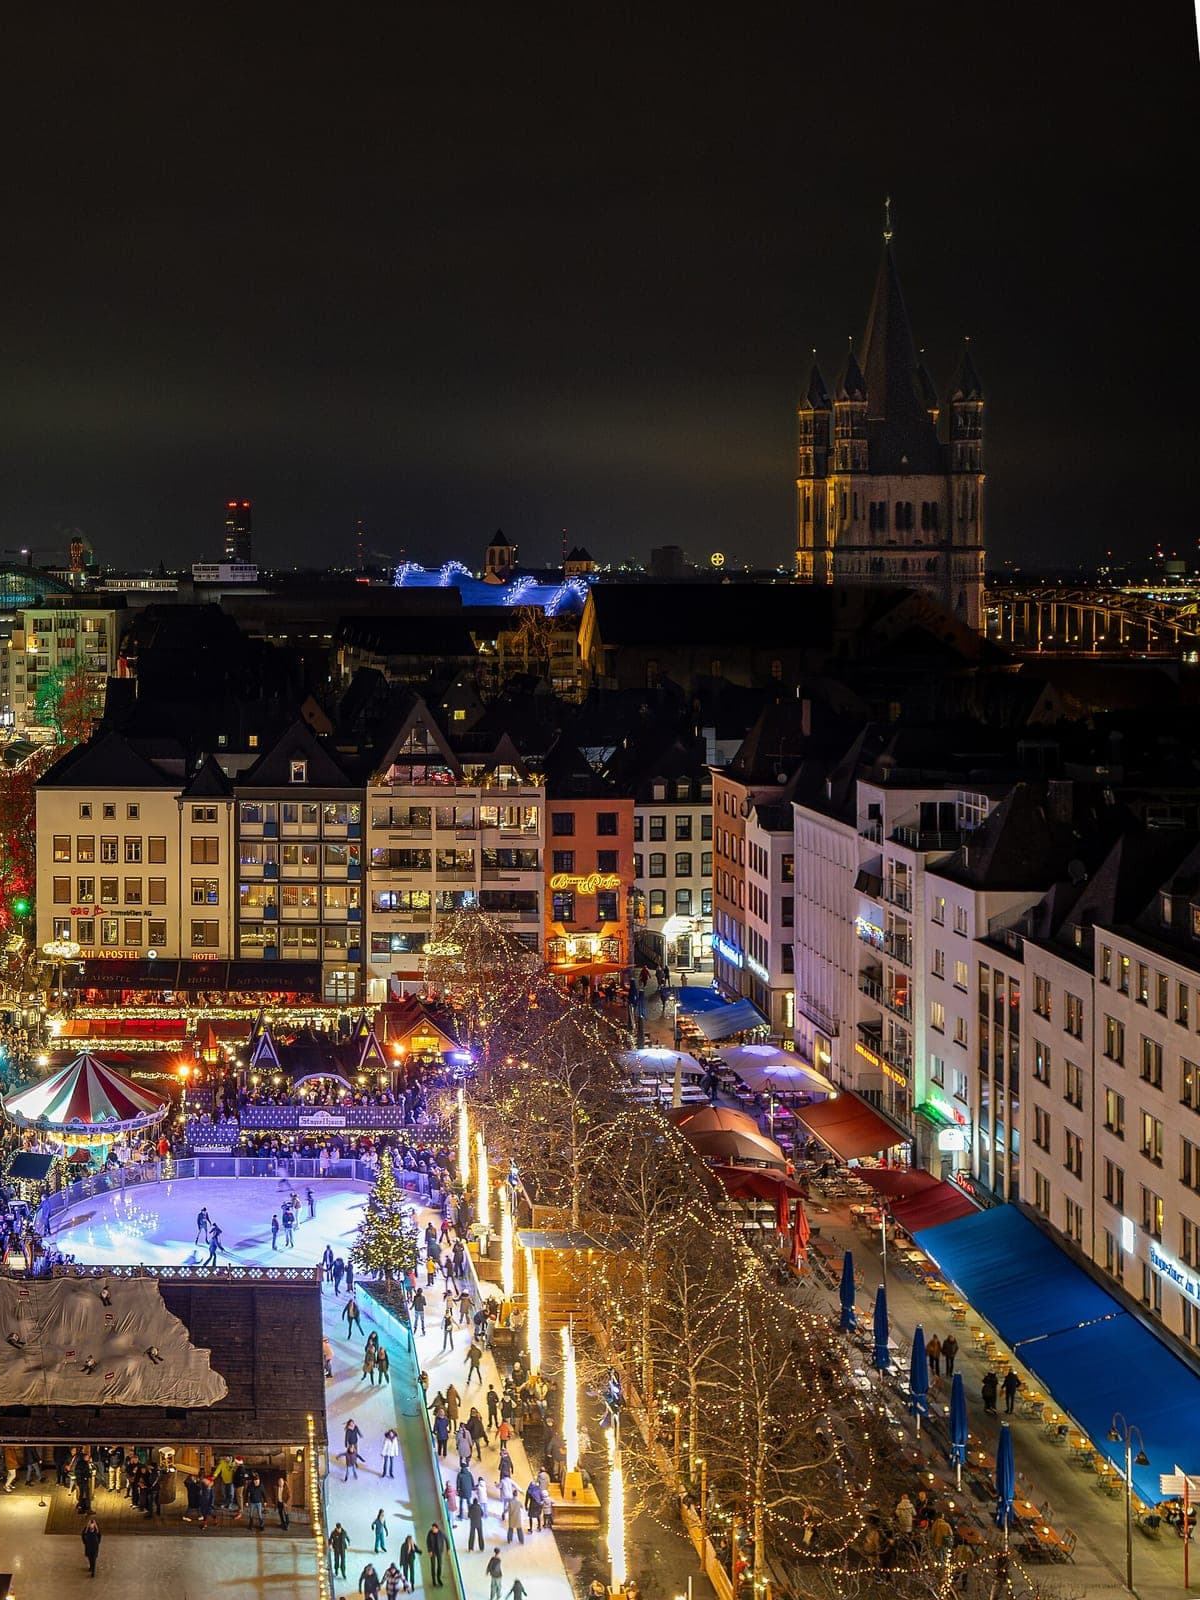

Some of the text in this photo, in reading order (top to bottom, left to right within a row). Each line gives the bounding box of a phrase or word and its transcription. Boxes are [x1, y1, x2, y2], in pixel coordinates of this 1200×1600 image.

[80, 950, 140, 959] XII APOSTEL
[192, 952, 219, 960] HOTEL
